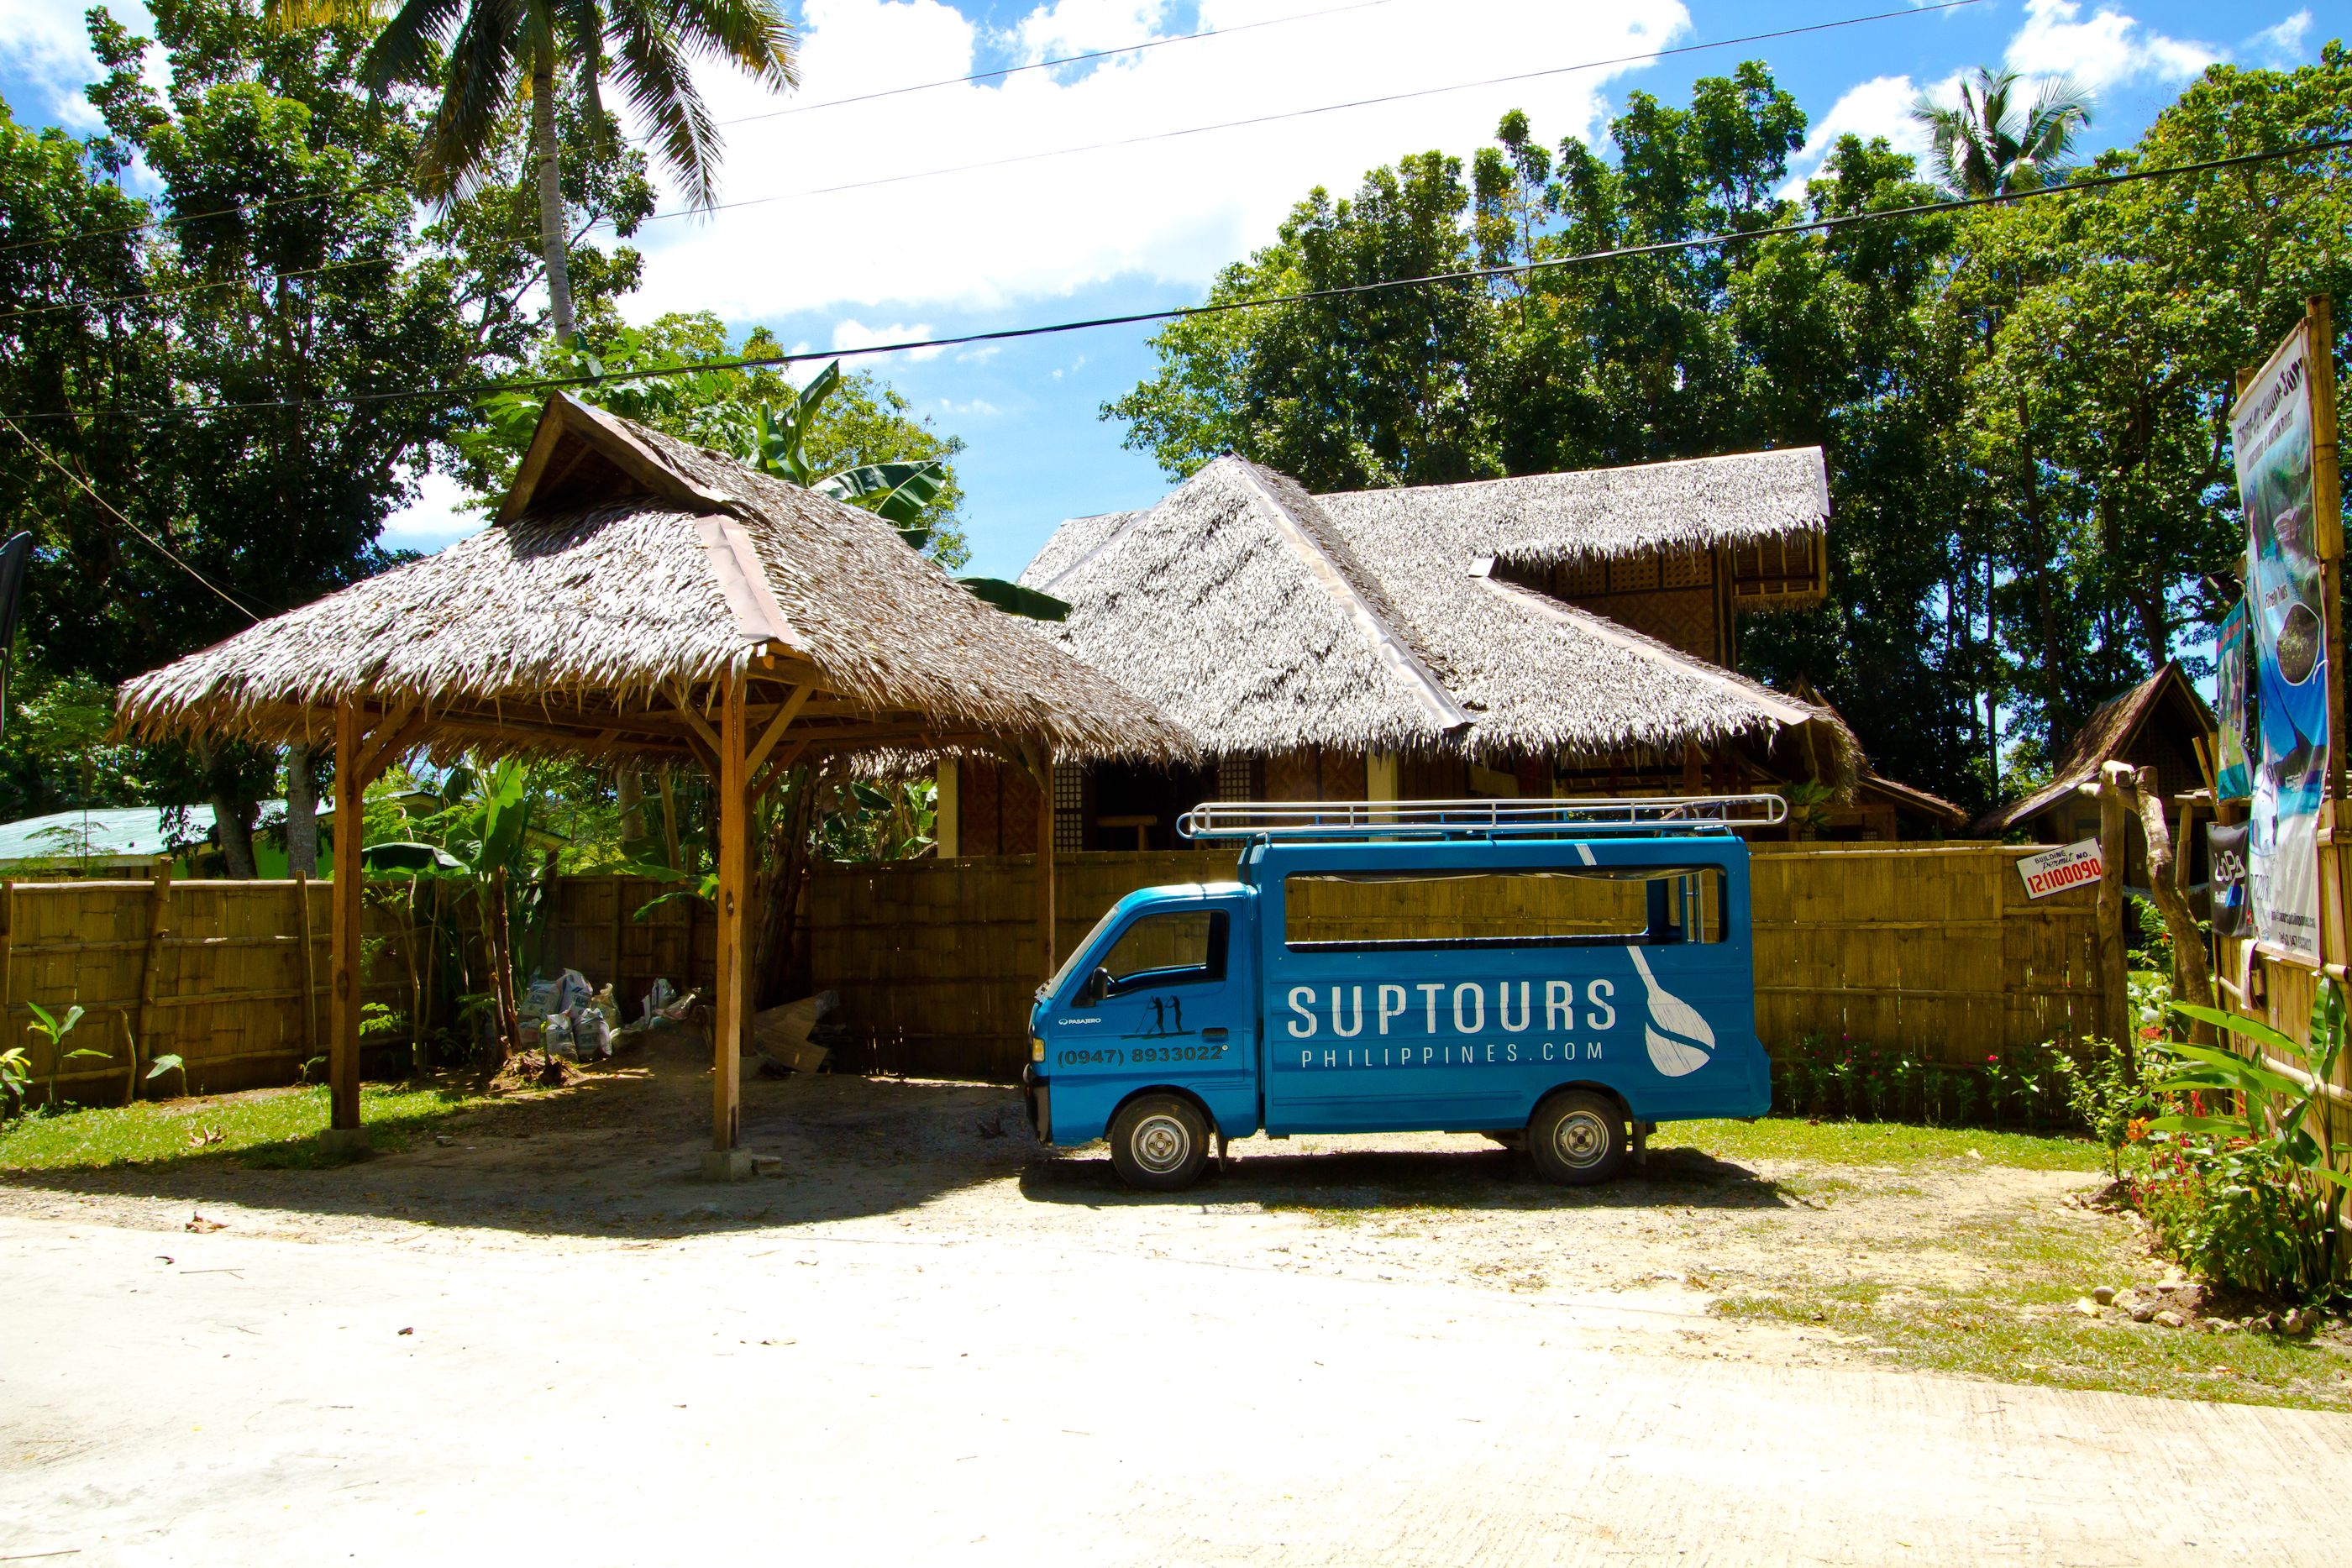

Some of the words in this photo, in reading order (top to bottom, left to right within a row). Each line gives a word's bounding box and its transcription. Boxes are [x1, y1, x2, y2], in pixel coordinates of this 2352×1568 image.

[2034, 850, 2066, 864] BUILDING
[2041, 852, 2074, 872] permit
[2027, 857, 2102, 894] 121100090
[1287, 978, 1617, 1039] SUPTOURS
[1068, 1017, 1102, 1025] PASAJERO
[1057, 1049, 1125, 1068] (0947)
[1131, 1045, 1223, 1063] 8933022
[1301, 1041, 1604, 1068] PHILIPPINES.COM
